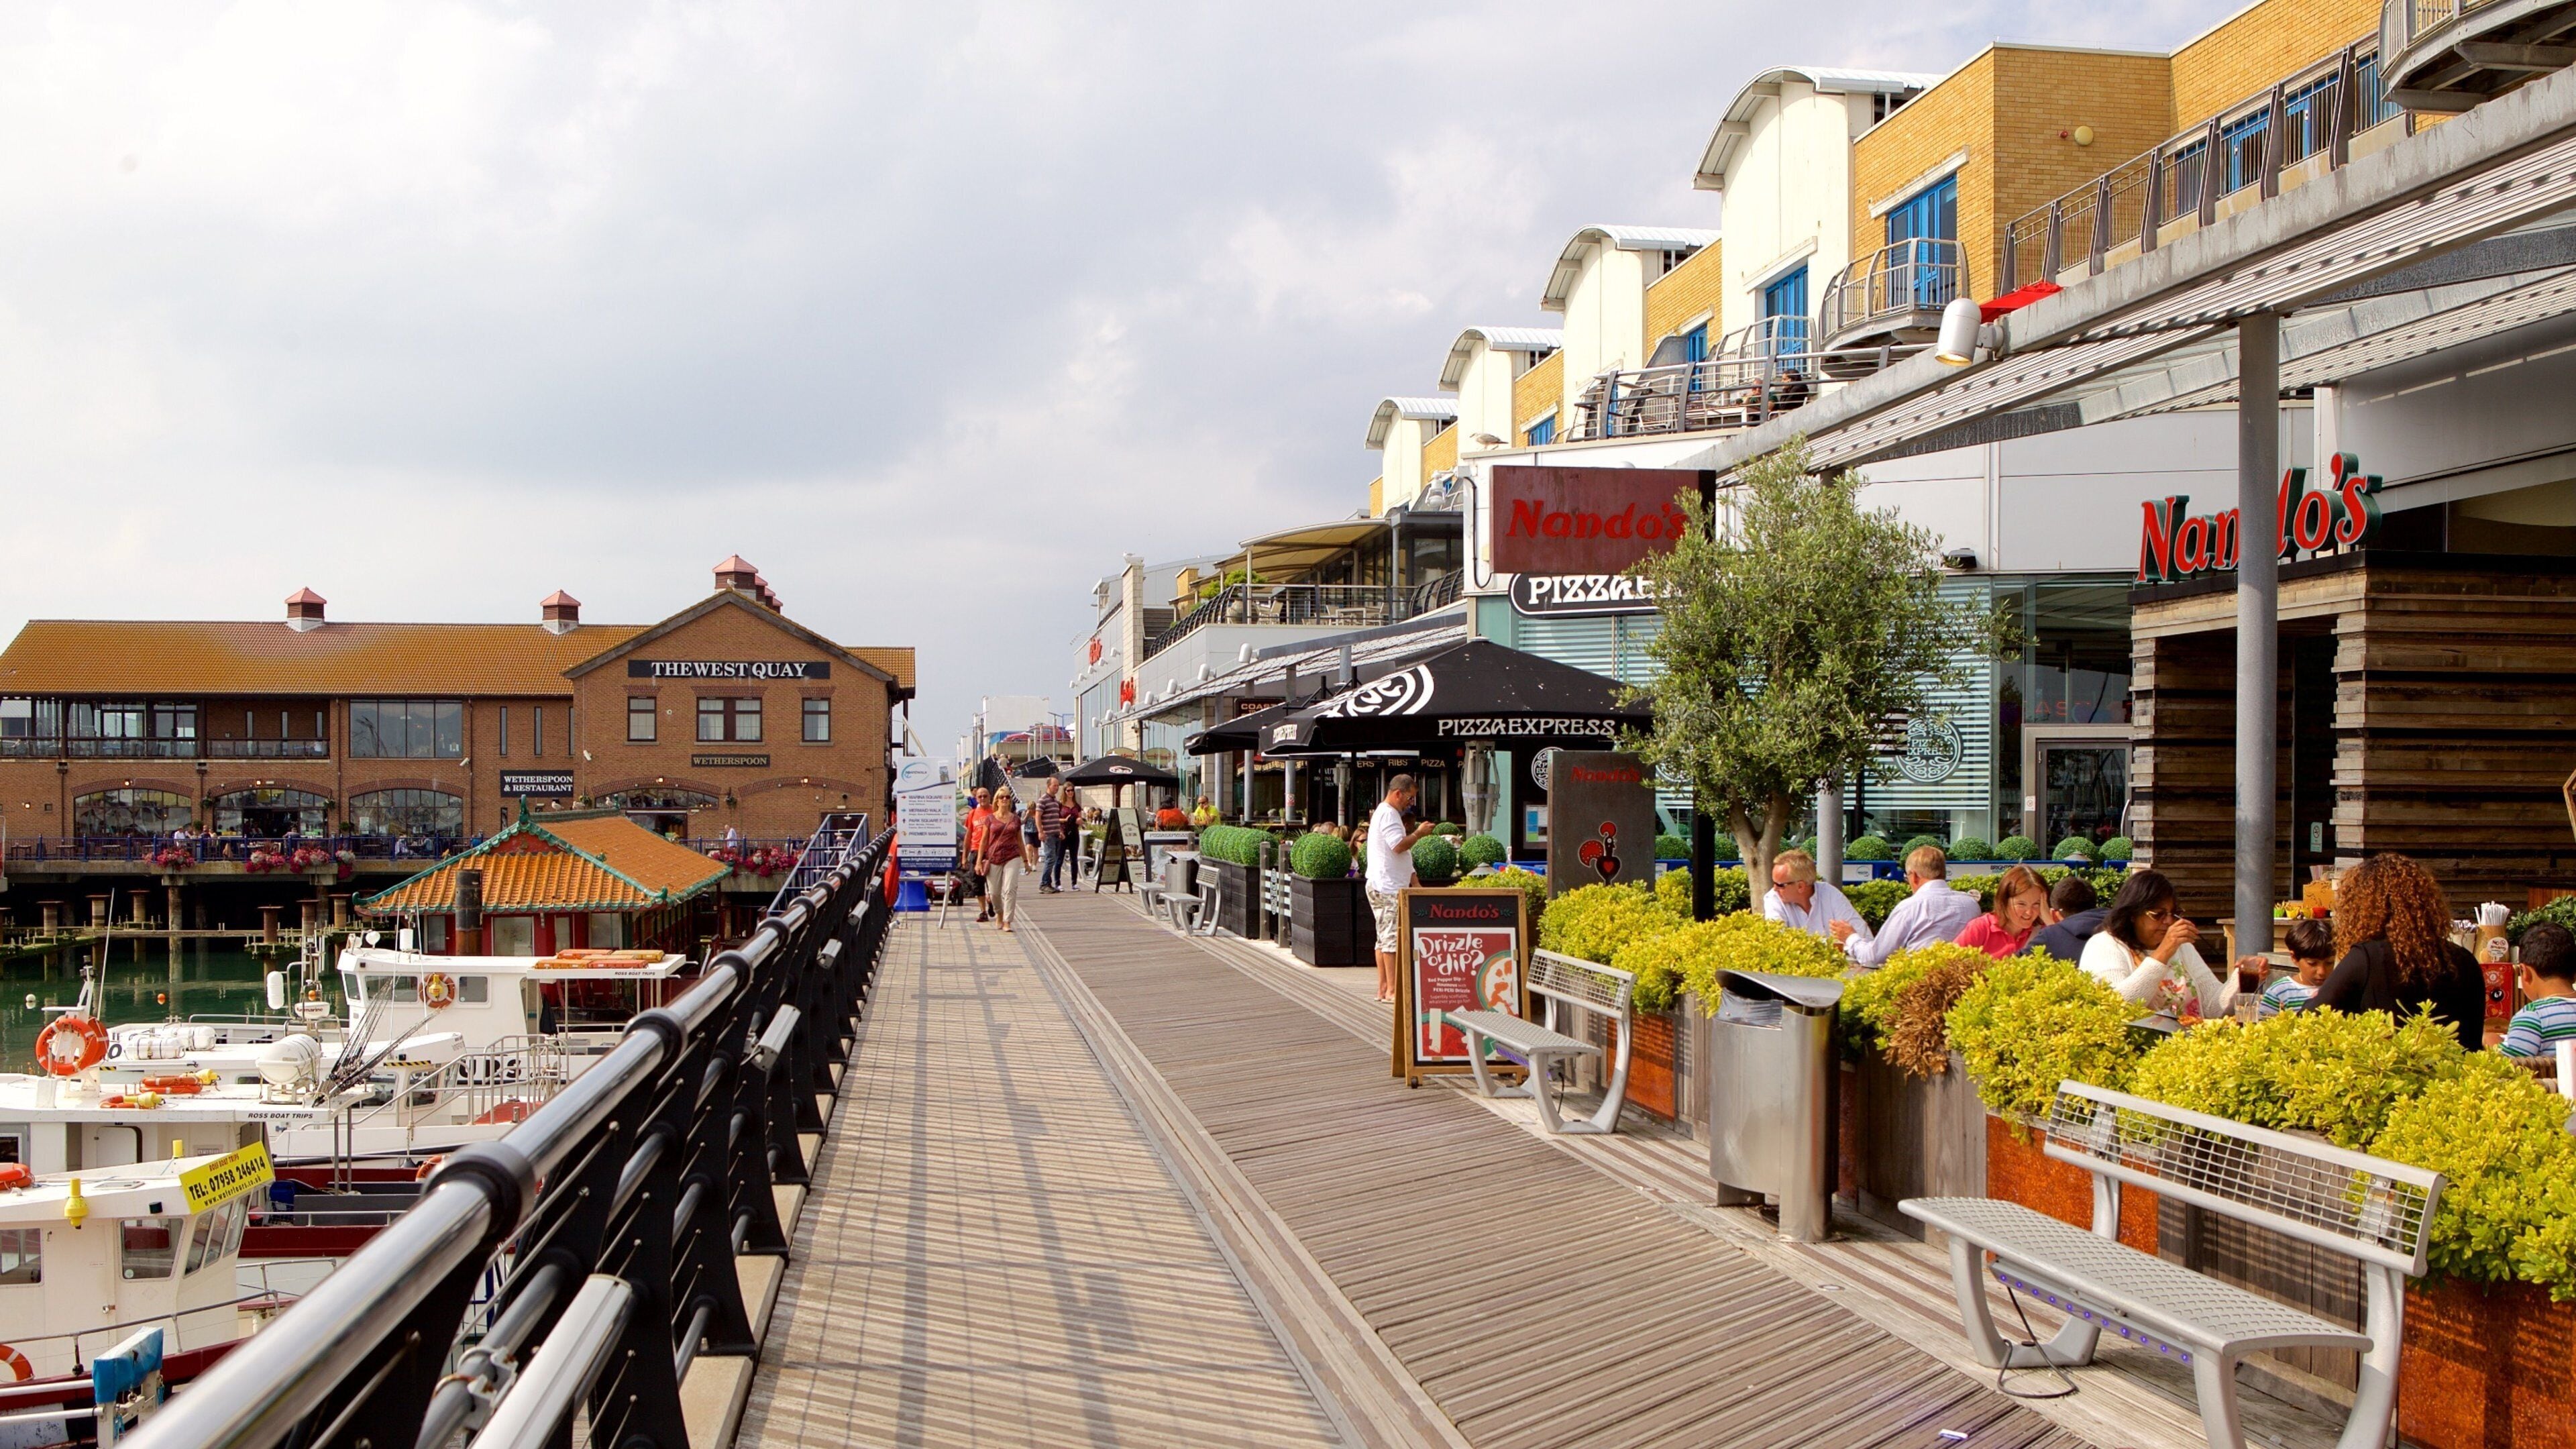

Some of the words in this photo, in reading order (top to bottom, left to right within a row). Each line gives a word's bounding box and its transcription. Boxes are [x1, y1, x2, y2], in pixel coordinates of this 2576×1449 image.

[1506, 498, 1686, 540] Nando's
[651, 661, 692, 677] THE
[692, 661, 749, 677] WEST
[751, 662, 807, 680] QUAY
[1438, 718, 1615, 736] PIZZAEXPRESS
[693, 757, 767, 765] WETHERSPOON
[1388, 759, 1408, 767] RIBS
[1421, 759, 1445, 767] PIZZA
[504, 775, 573, 784] WETHERSPOON
[1570, 766, 1640, 783] Nando's
[1429, 904, 1499, 919] Nando's
[1418, 932, 1483, 959] Drizzle
[1428, 953, 1442, 966] or
[1438, 949, 1485, 976] dip?
[209, 1163, 219, 1172] ROSS
[219, 1157, 228, 1169] BOAT
[228, 1153, 239, 1163] TRIPS
[189, 1182, 209, 1201] TEL:
[209, 1169, 235, 1192] 07958
[235, 1156, 266, 1180] 246414
